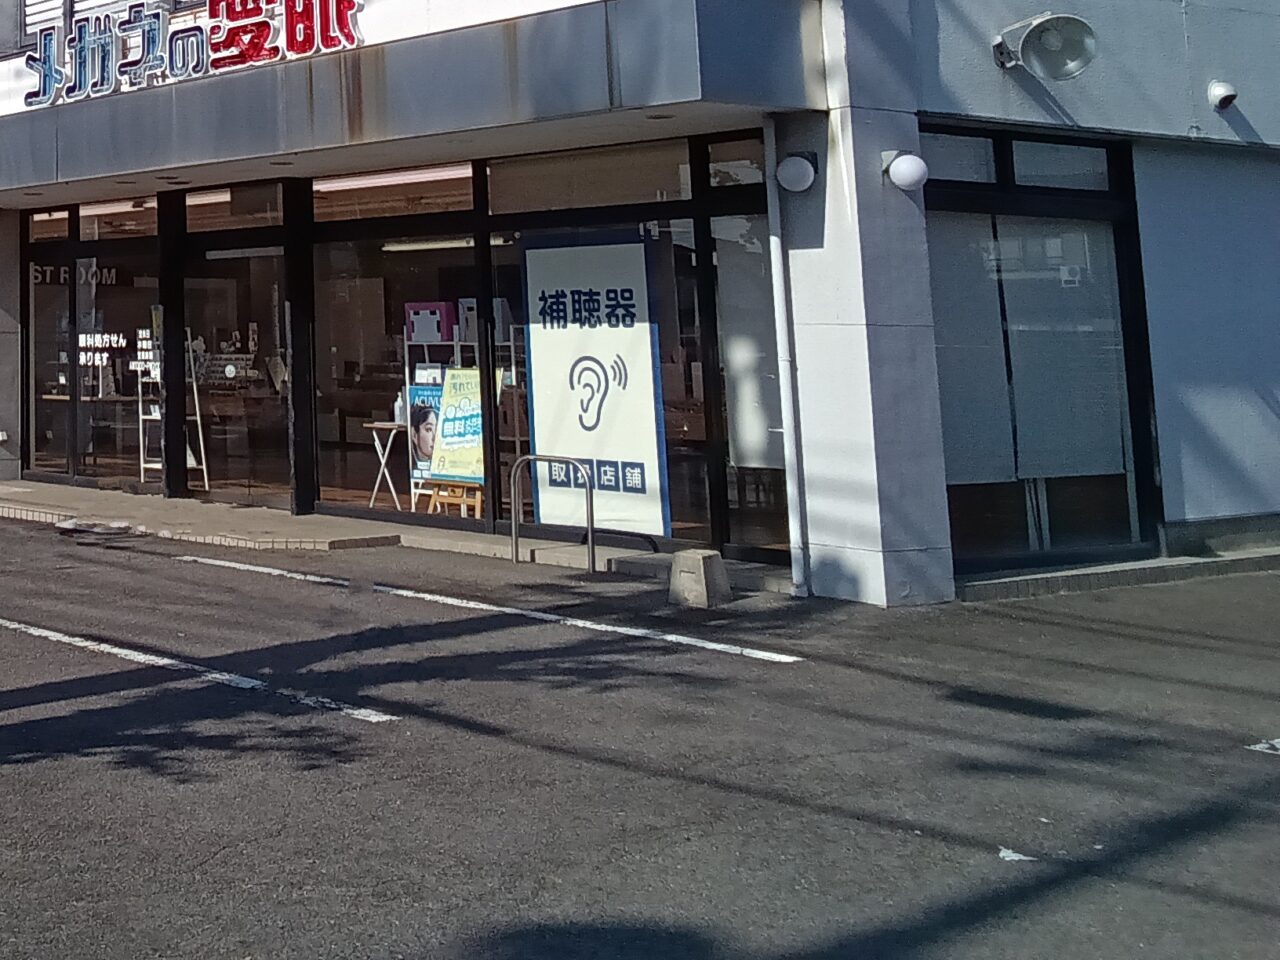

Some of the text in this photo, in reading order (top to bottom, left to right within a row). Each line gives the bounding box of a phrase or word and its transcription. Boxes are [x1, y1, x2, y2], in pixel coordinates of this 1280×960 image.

[538, 288, 636, 329] 補聴器
[79, 333, 127, 348] 眼科処方せん
